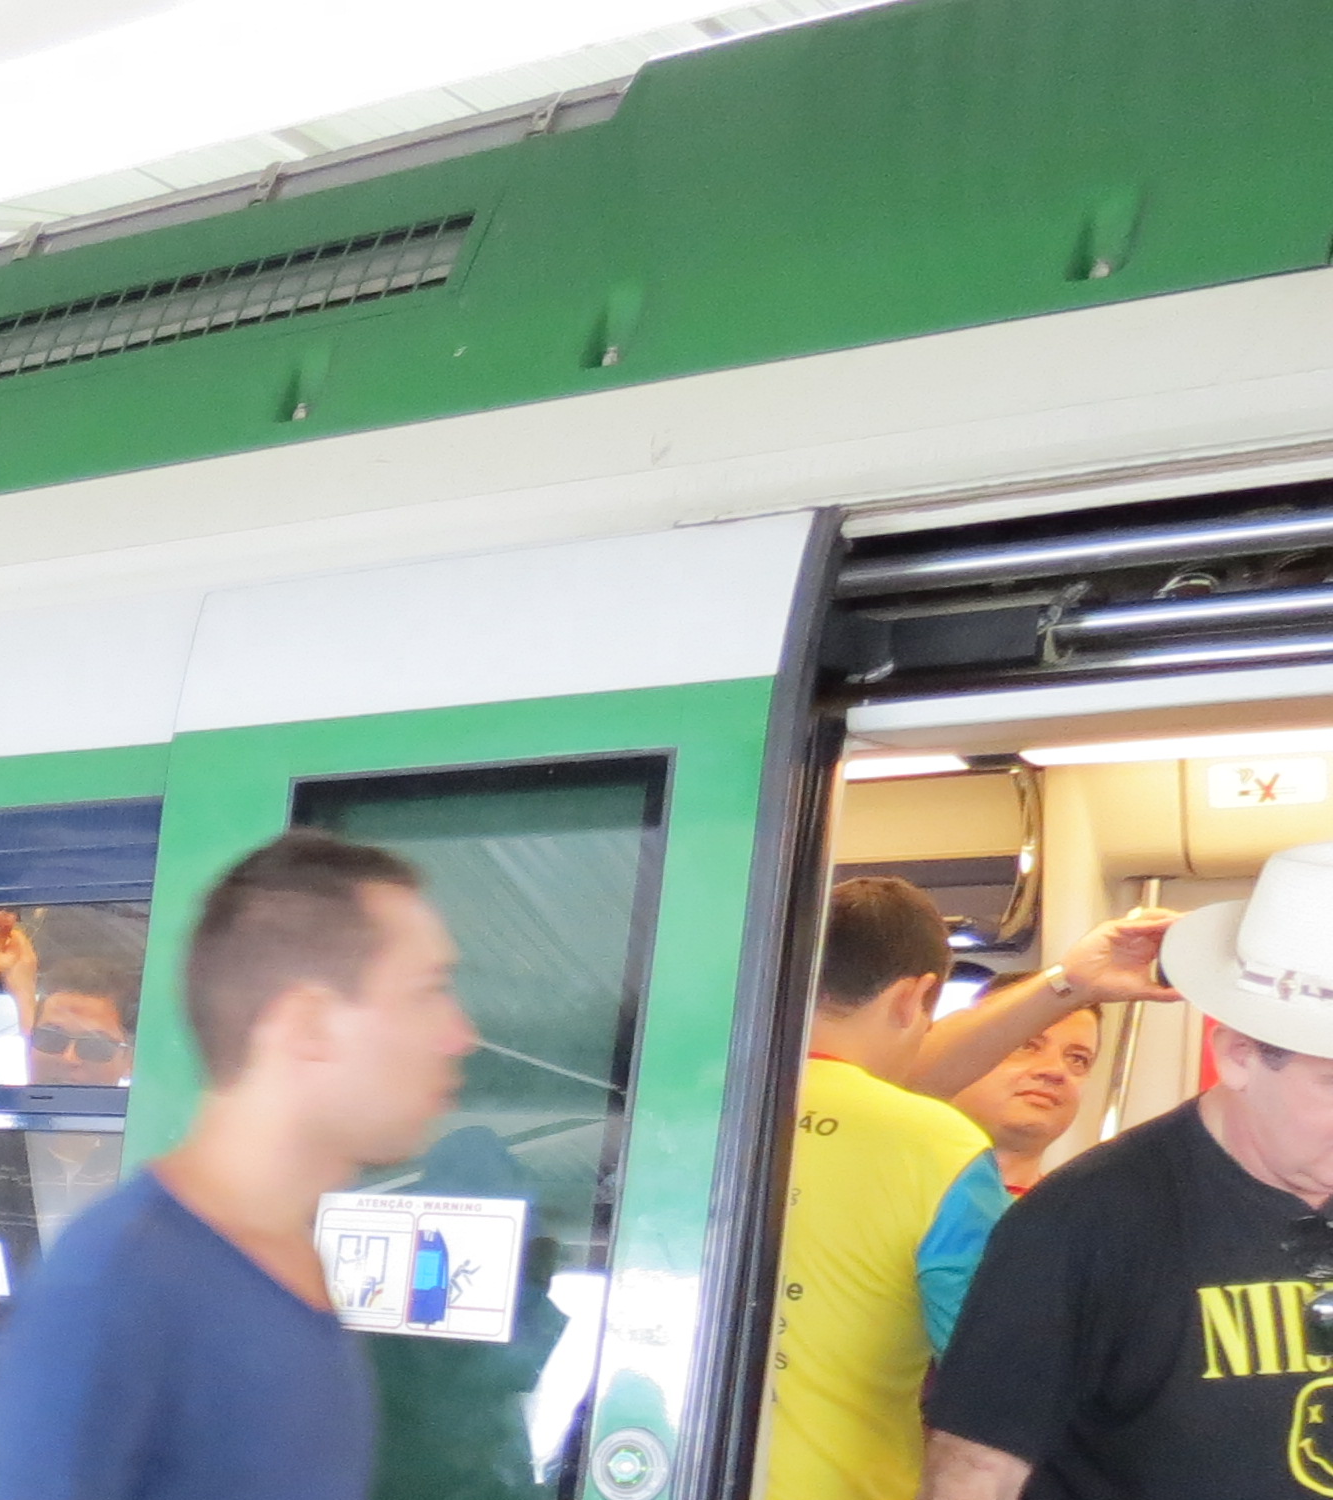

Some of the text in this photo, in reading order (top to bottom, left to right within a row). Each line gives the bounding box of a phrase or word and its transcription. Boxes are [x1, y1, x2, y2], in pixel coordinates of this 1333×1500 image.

[356, 1197, 414, 1211] ATENÇÃO
[422, 1200, 483, 1213] WARNING
[1196, 1280, 1333, 1379] NIR
